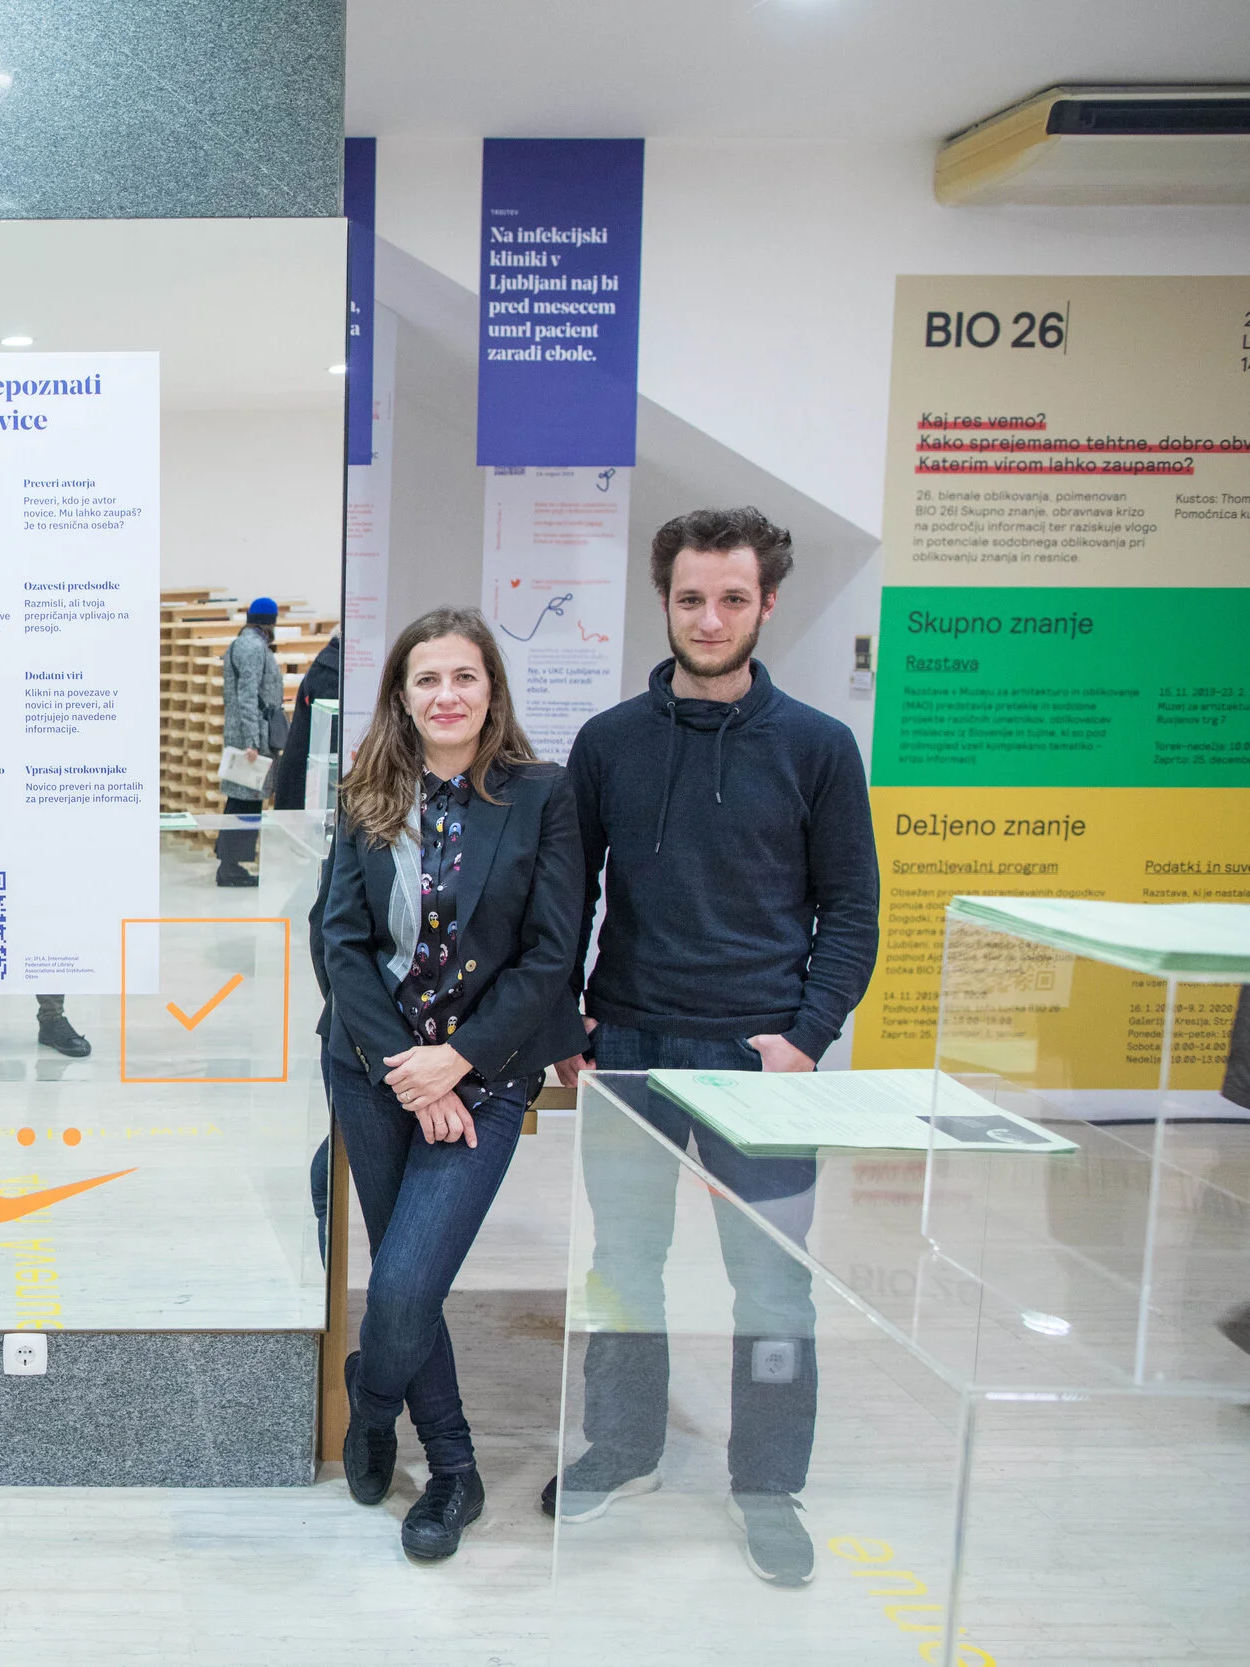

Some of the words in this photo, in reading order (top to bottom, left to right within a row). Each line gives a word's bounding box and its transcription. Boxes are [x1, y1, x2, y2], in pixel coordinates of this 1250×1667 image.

[491, 227, 513, 242] Na
[518, 227, 607, 247] infekcijski
[490, 250, 547, 267] kliniki
[551, 255, 561, 267] v
[490, 274, 566, 294] Ljubljani
[571, 275, 598, 294] naj
[602, 275, 618, 290] bi
[489, 298, 529, 318] pred
[534, 302, 615, 314] mesecem
[489, 321, 531, 337] umrl
[535, 322, 598, 342] pacient
[925, 311, 1001, 348] BIO
[488, 345, 541, 361] zaradi
[545, 345, 596, 361] ebole.
[922, 412, 948, 430] Kaj
[954, 416, 982, 428] res
[988, 413, 1046, 428] vemo?
[921, 435, 963, 450] Kako
[969, 435, 1080, 453] sprejemamo
[1086, 436, 1152, 451] tehtne,
[1158, 436, 1214, 450] dobro
[919, 456, 988, 471] Katerim
[994, 457, 1043, 471] virom
[1050, 457, 1097, 472] lahko
[1102, 457, 1194, 475] zaupamo?
[24, 479, 59, 488] Preveri
[61, 479, 95, 489] avtorja
[23, 496, 59, 507] Preveri,
[62, 496, 79, 505] kdo
[81, 496, 90, 508] je
[92, 497, 116, 506] avtor
[23, 509, 57, 518] novice.
[59, 509, 73, 518] Mu
[75, 508, 101, 518] lahko
[103, 508, 142, 520] zaupaš?
[24, 522, 35, 530] Je
[37, 522, 47, 530] to
[49, 521, 89, 530] resnična
[91, 521, 124, 529] oseba?
[24, 582, 65, 590] Ozavesti
[67, 581, 120, 592] predsodke
[24, 598, 66, 610] Razmisli,
[69, 598, 80, 608] ali
[82, 598, 105, 610] tvoja
[24, 611, 77, 622] prepričanja
[79, 610, 116, 622] vplivajo
[118, 612, 129, 620] na
[24, 623, 61, 634] presojo.
[907, 610, 1003, 639] Skupno
[1010, 612, 1094, 640] znanje
[906, 655, 979, 671] Razstava
[25, 671, 64, 680] Dodatni
[66, 671, 83, 680] viri
[25, 688, 51, 697] Klikni
[67, 690, 110, 699] povezave
[25, 701, 52, 709] novici
[54, 701, 63, 709] in
[65, 700, 101, 711] preveri,
[103, 700, 114, 709] ali
[25, 713, 69, 723] potrjujejo
[72, 712, 116, 721] navedene
[25, 724, 80, 735] informacije.
[26, 766, 62, 776] Vprašaj
[64, 765, 127, 776] strokovnjake
[26, 782, 57, 791] Novico
[59, 782, 92, 792] preveri
[108, 782, 144, 792] portalih
[38, 794, 90, 804] preverjanje
[93, 794, 141, 804] informacij.
[896, 814, 996, 841] Deljeno
[1003, 815, 1086, 842] znanje
[893, 860, 994, 874] Spremljevalni
[998, 863, 1058, 875] program
[1145, 861, 1200, 874] Podatki
[1207, 861, 1220, 873] in
